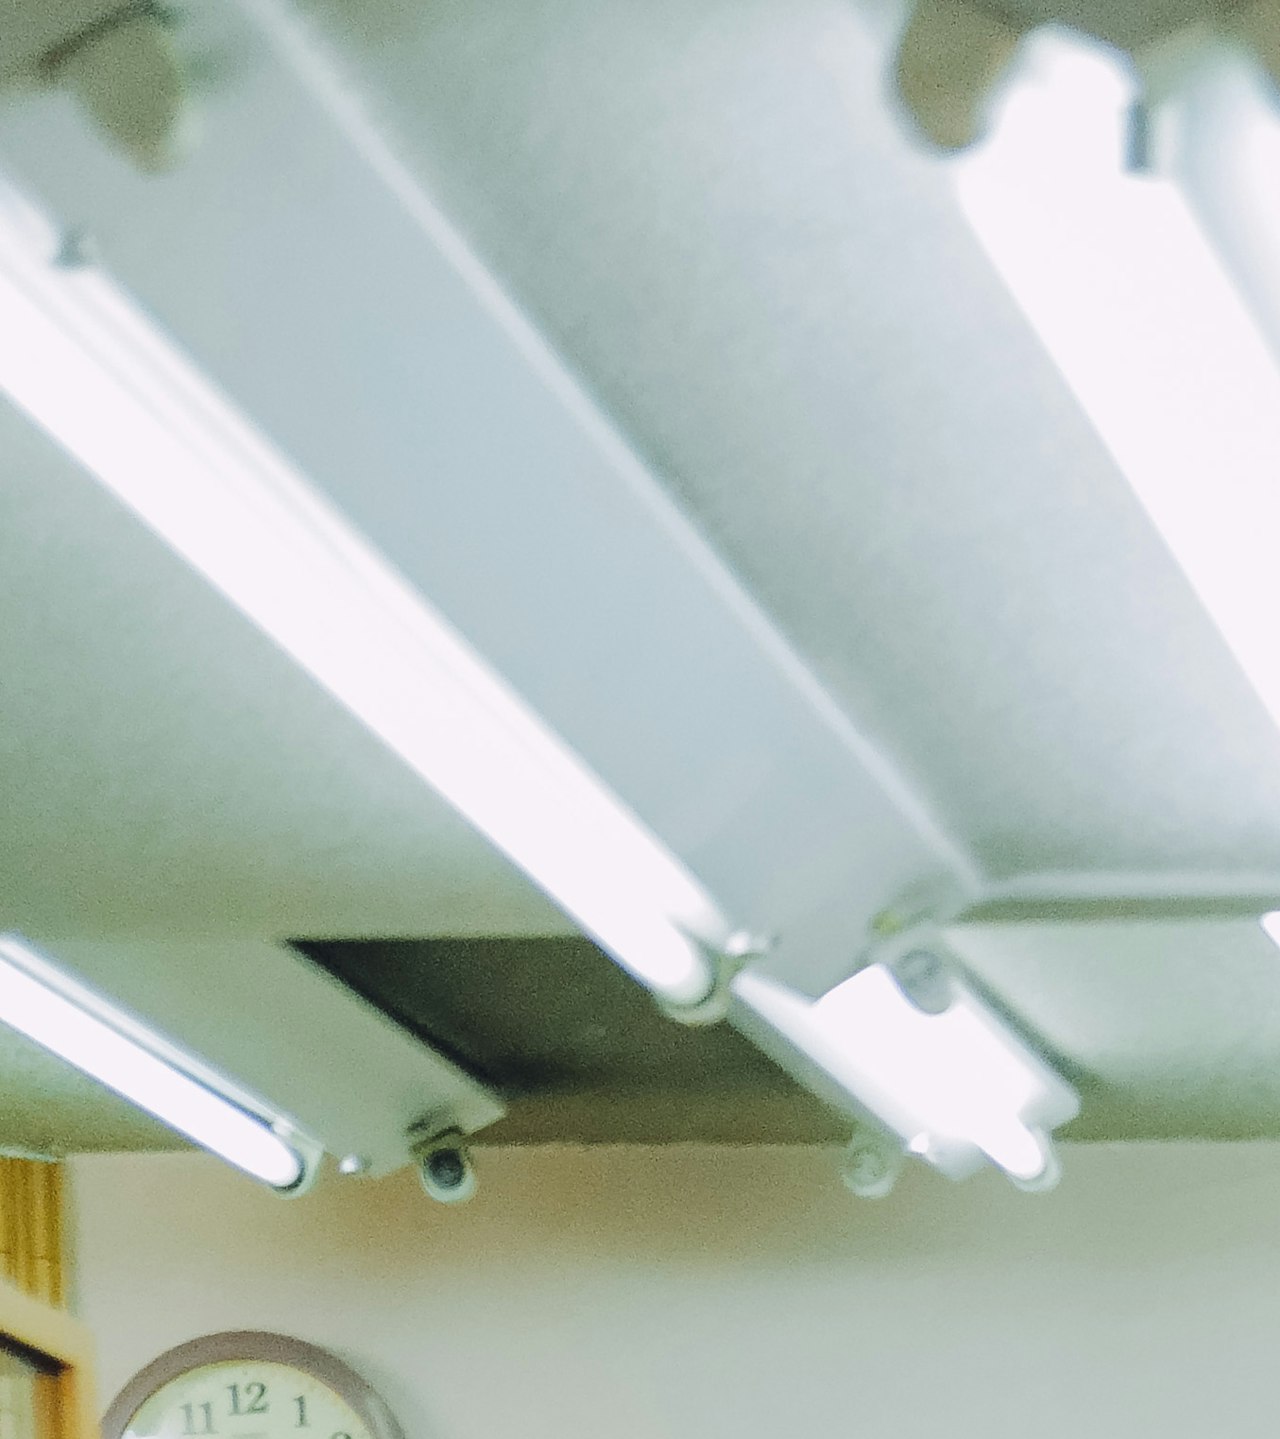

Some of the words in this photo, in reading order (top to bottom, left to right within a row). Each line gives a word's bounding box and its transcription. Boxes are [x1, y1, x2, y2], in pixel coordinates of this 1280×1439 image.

[226, 1381, 269, 1416] 12
[293, 1394, 311, 1428] 1
[180, 1401, 219, 1436] 11
